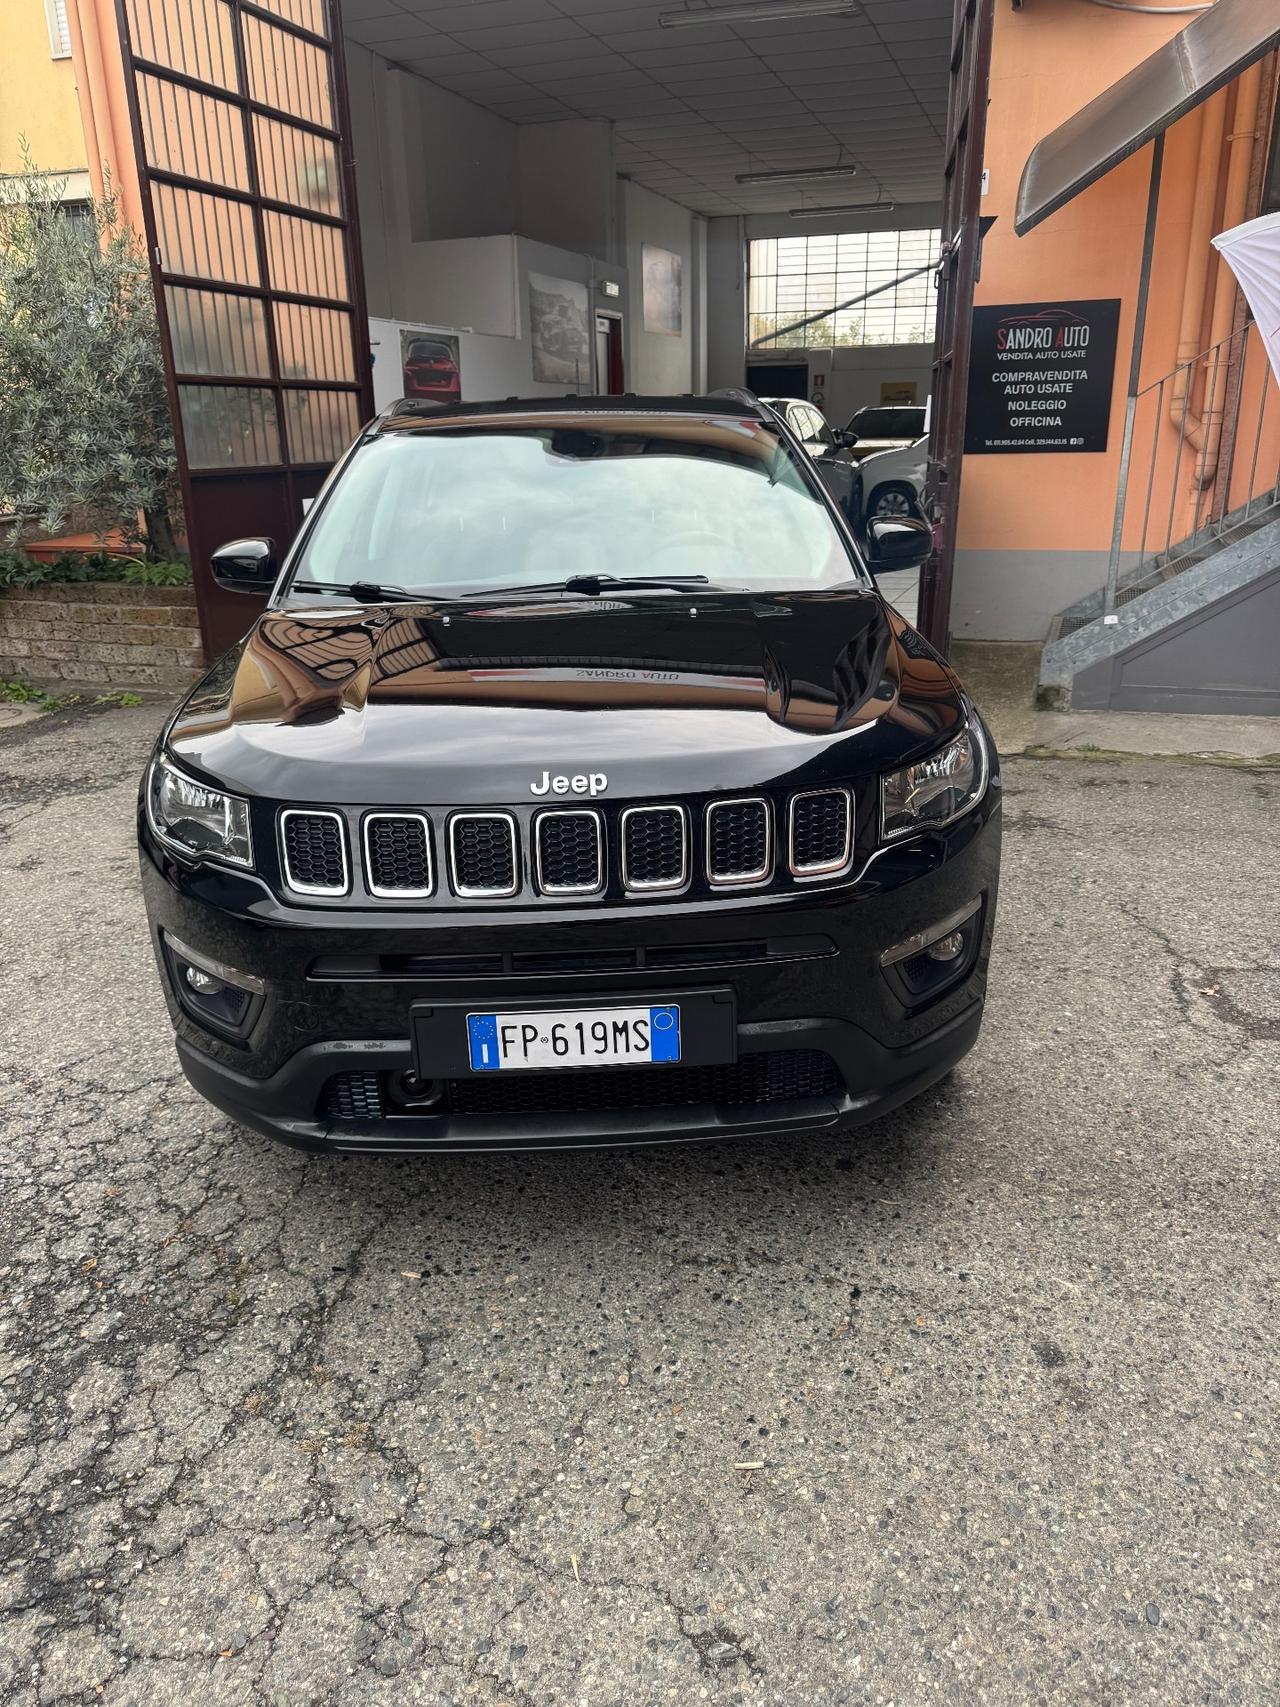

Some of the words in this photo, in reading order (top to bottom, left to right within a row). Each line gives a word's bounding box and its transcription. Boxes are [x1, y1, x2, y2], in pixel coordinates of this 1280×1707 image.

[997, 327, 1052, 350] SANDRO
[1056, 325, 1090, 347] AUTO
[997, 352, 1033, 360] VENDITA
[1035, 351, 1059, 360] AUTO
[1061, 350, 1086, 358] USATE
[992, 370, 1088, 382] COMPRAVENDITA
[1004, 384, 1034, 395] AUTO
[1037, 383, 1073, 393] USATE
[1008, 400, 1067, 411] NOLEGGIO
[1010, 416, 1062, 427] OFFICINA
[530, 771, 608, 796] Jeep
[501, 1025, 538, 1058] FP
[551, 1019, 650, 1056] 619MS
